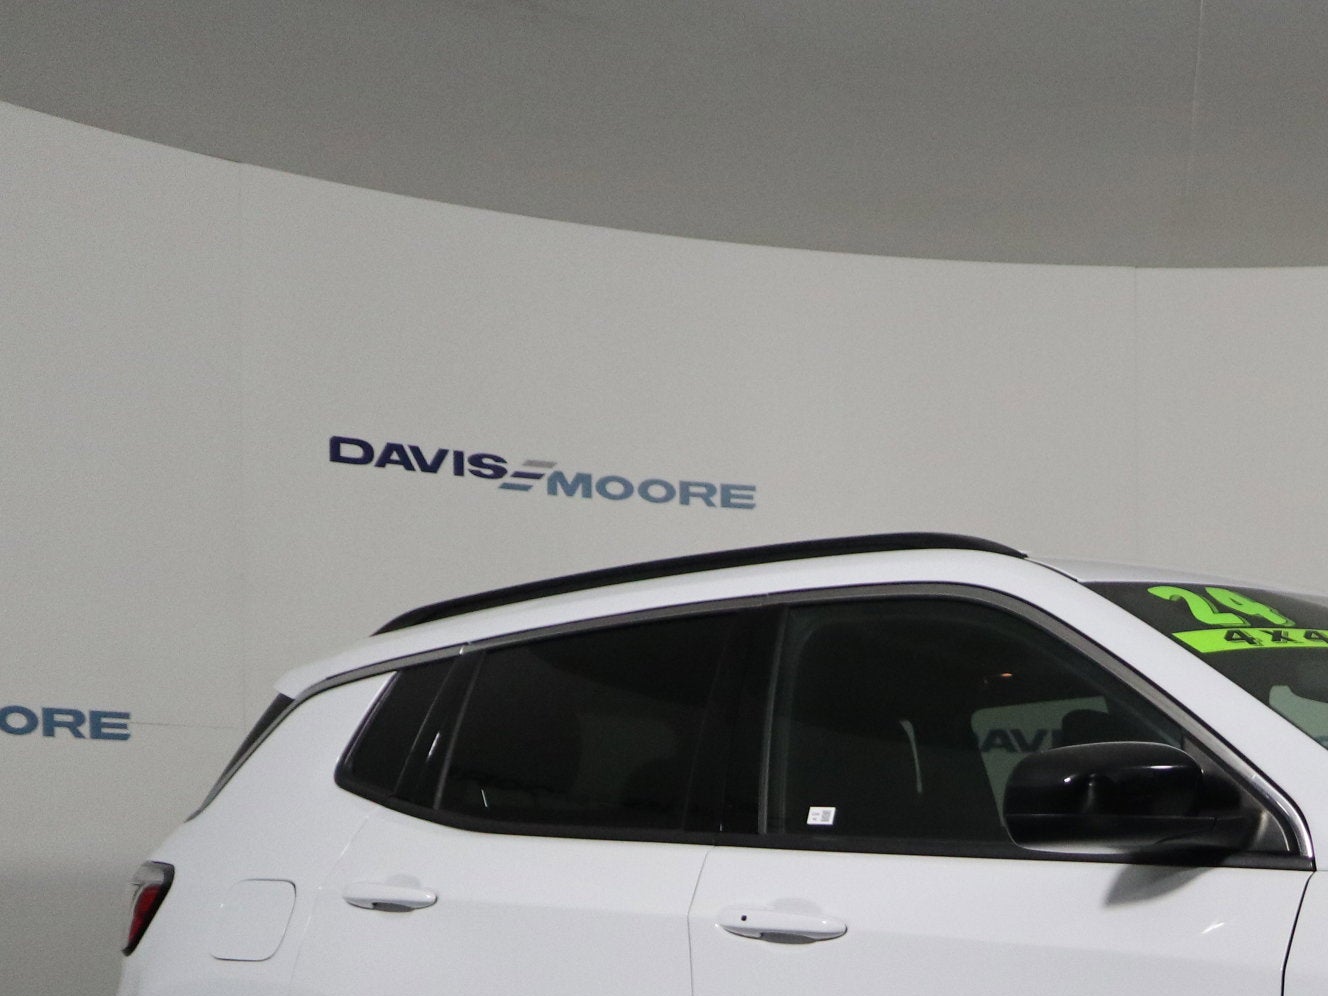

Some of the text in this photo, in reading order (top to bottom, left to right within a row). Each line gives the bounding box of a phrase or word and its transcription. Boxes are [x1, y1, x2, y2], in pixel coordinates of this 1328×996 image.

[329, 435, 757, 509] DAVIS MOORE
[1147, 585, 1296, 628] 24
[0, 705, 131, 741] ORE
